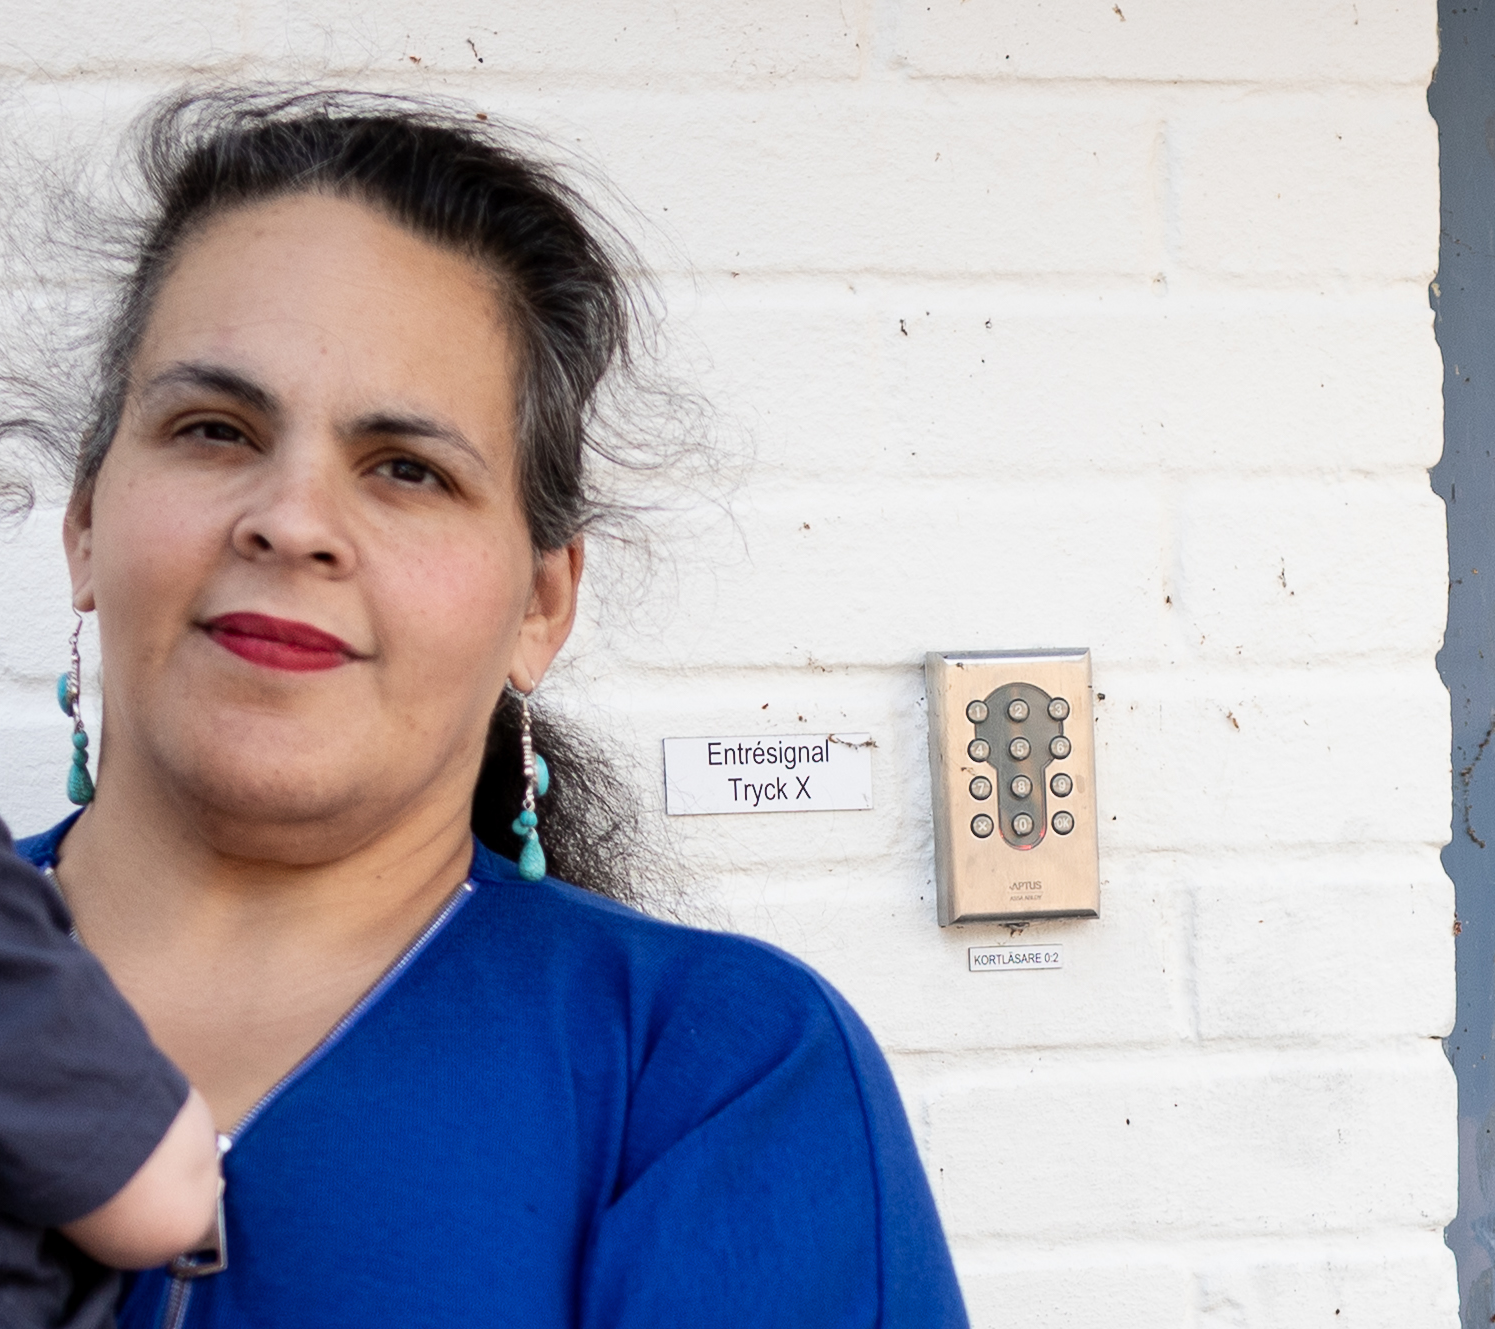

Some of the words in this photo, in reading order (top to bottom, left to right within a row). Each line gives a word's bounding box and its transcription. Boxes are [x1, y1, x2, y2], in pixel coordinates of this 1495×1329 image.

[974, 705, 981, 718] 1
[1014, 704, 1023, 717] 2
[1055, 703, 1063, 716] 3
[707, 738, 830, 770] Entrésignal
[975, 744, 984, 757] 4
[1016, 742, 1024, 756] 5
[1056, 741, 1065, 754] 6
[727, 776, 789, 807] Tryck
[795, 775, 812, 800] X
[976, 782, 985, 795] 7
[1017, 780, 1026, 793] 8
[1058, 778, 1066, 792] 9
[973, 951, 1042, 966] KORTLÄSARE
